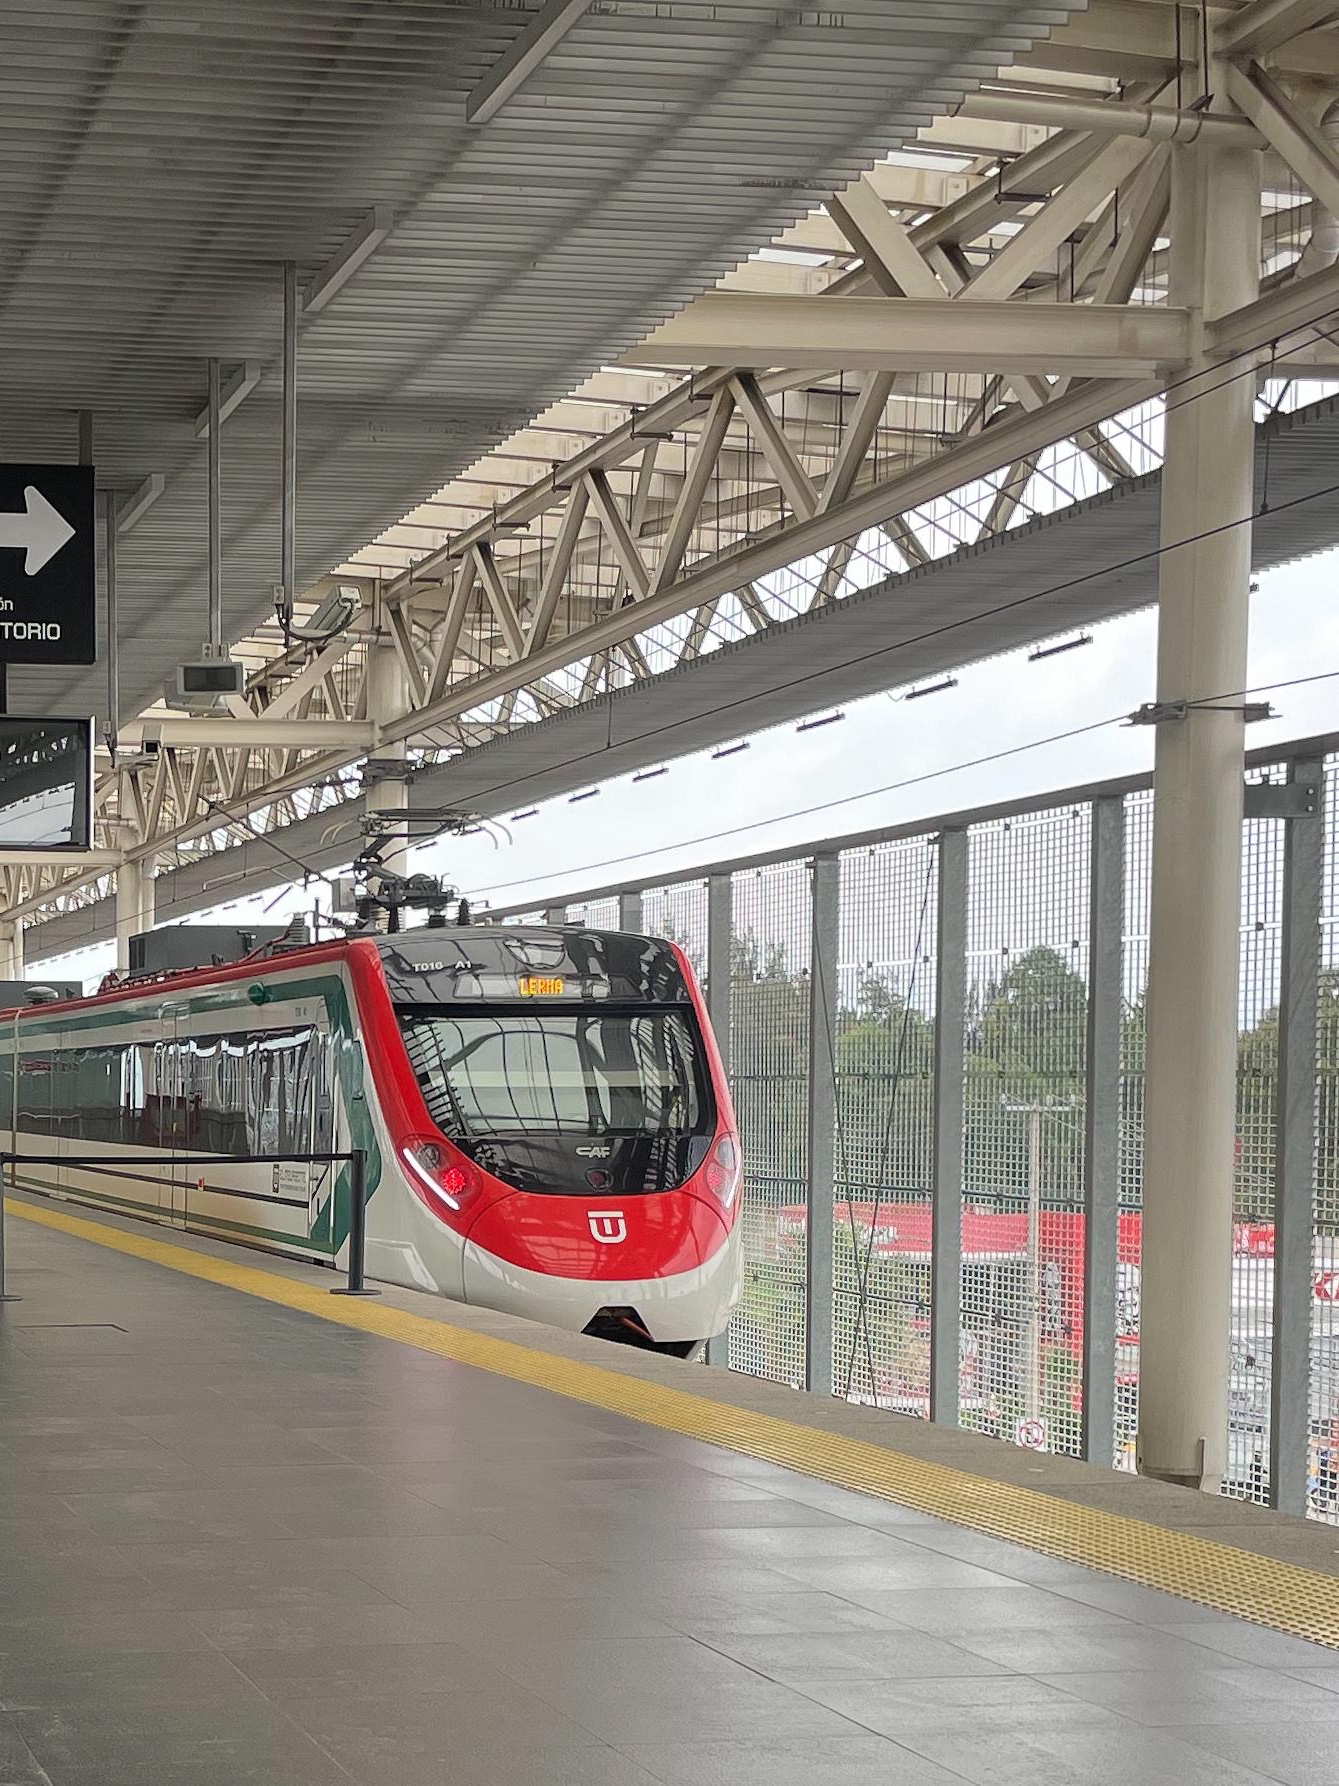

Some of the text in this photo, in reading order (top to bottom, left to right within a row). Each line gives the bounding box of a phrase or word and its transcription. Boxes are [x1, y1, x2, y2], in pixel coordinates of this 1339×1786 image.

[454, 960, 472, 969] A1
[519, 978, 564, 995] LERMA
[575, 1144, 610, 1159] CAF
